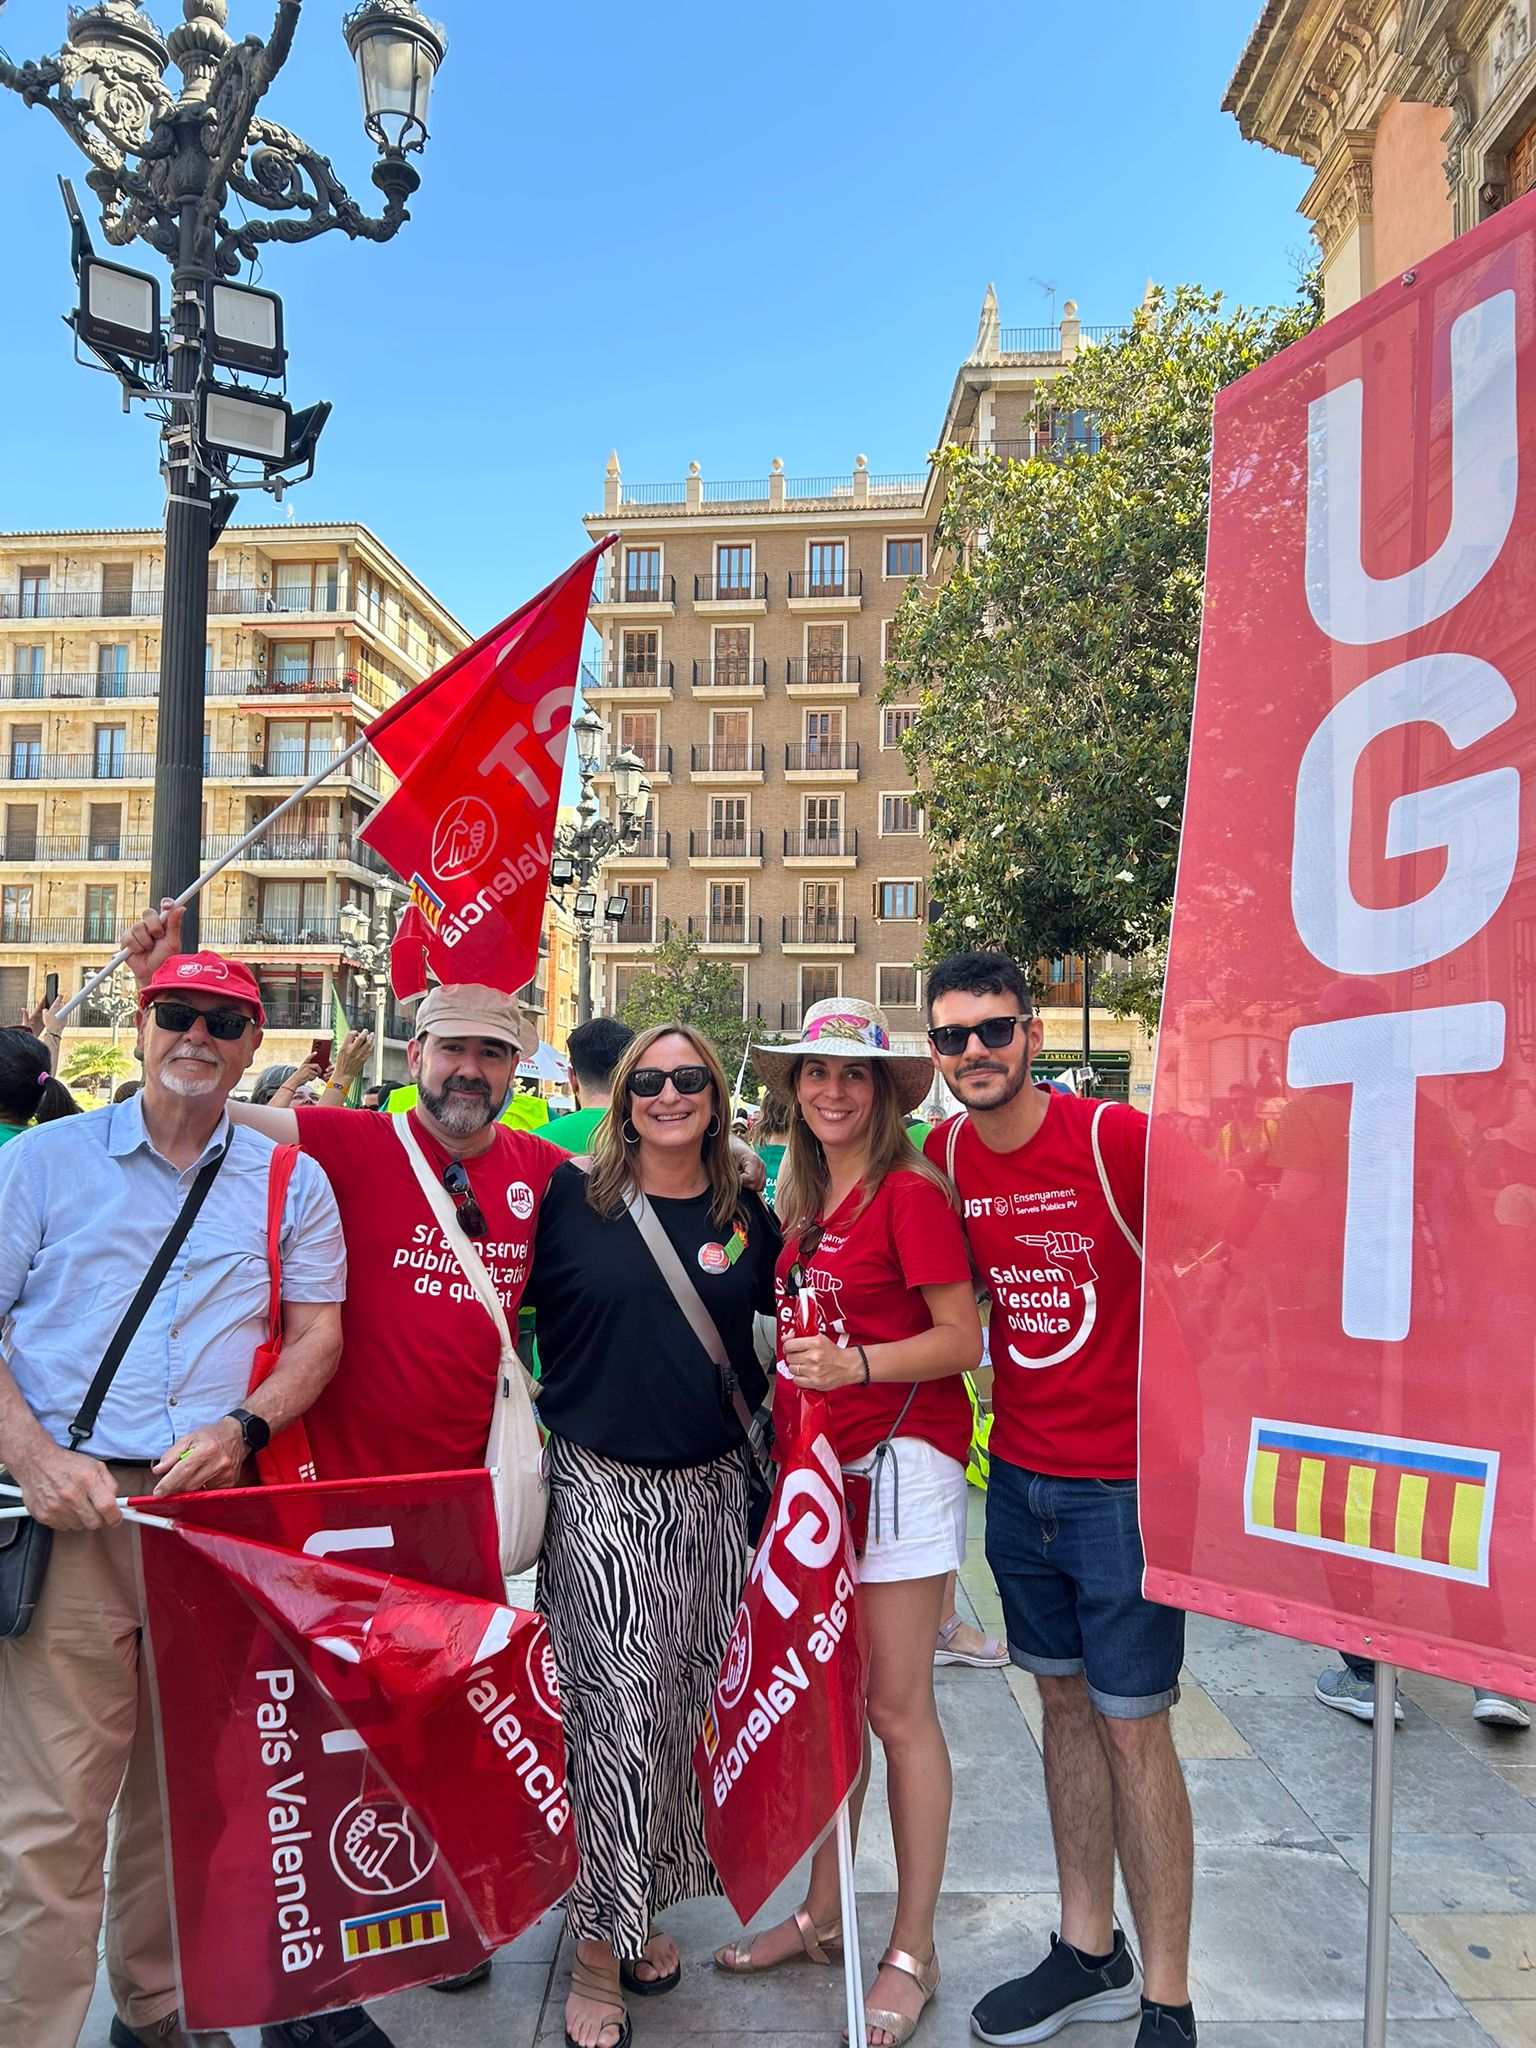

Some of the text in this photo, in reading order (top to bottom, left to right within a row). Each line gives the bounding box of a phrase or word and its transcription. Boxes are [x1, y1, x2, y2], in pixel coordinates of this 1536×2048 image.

[218, 344, 235, 353] 200W
[1286, 288, 1521, 1342] UGT
[510, 1188, 530, 1203] UGT
[1013, 1187, 1077, 1204] Ensenyament
[1066, 1200, 1078, 1209] PV
[412, 1224, 438, 1246] Sí
[989, 1264, 1066, 1285] Salvem
[413, 1274, 443, 1297] de
[997, 1286, 1071, 1309] l'escola
[256, 1669, 325, 1974] País Valencià
